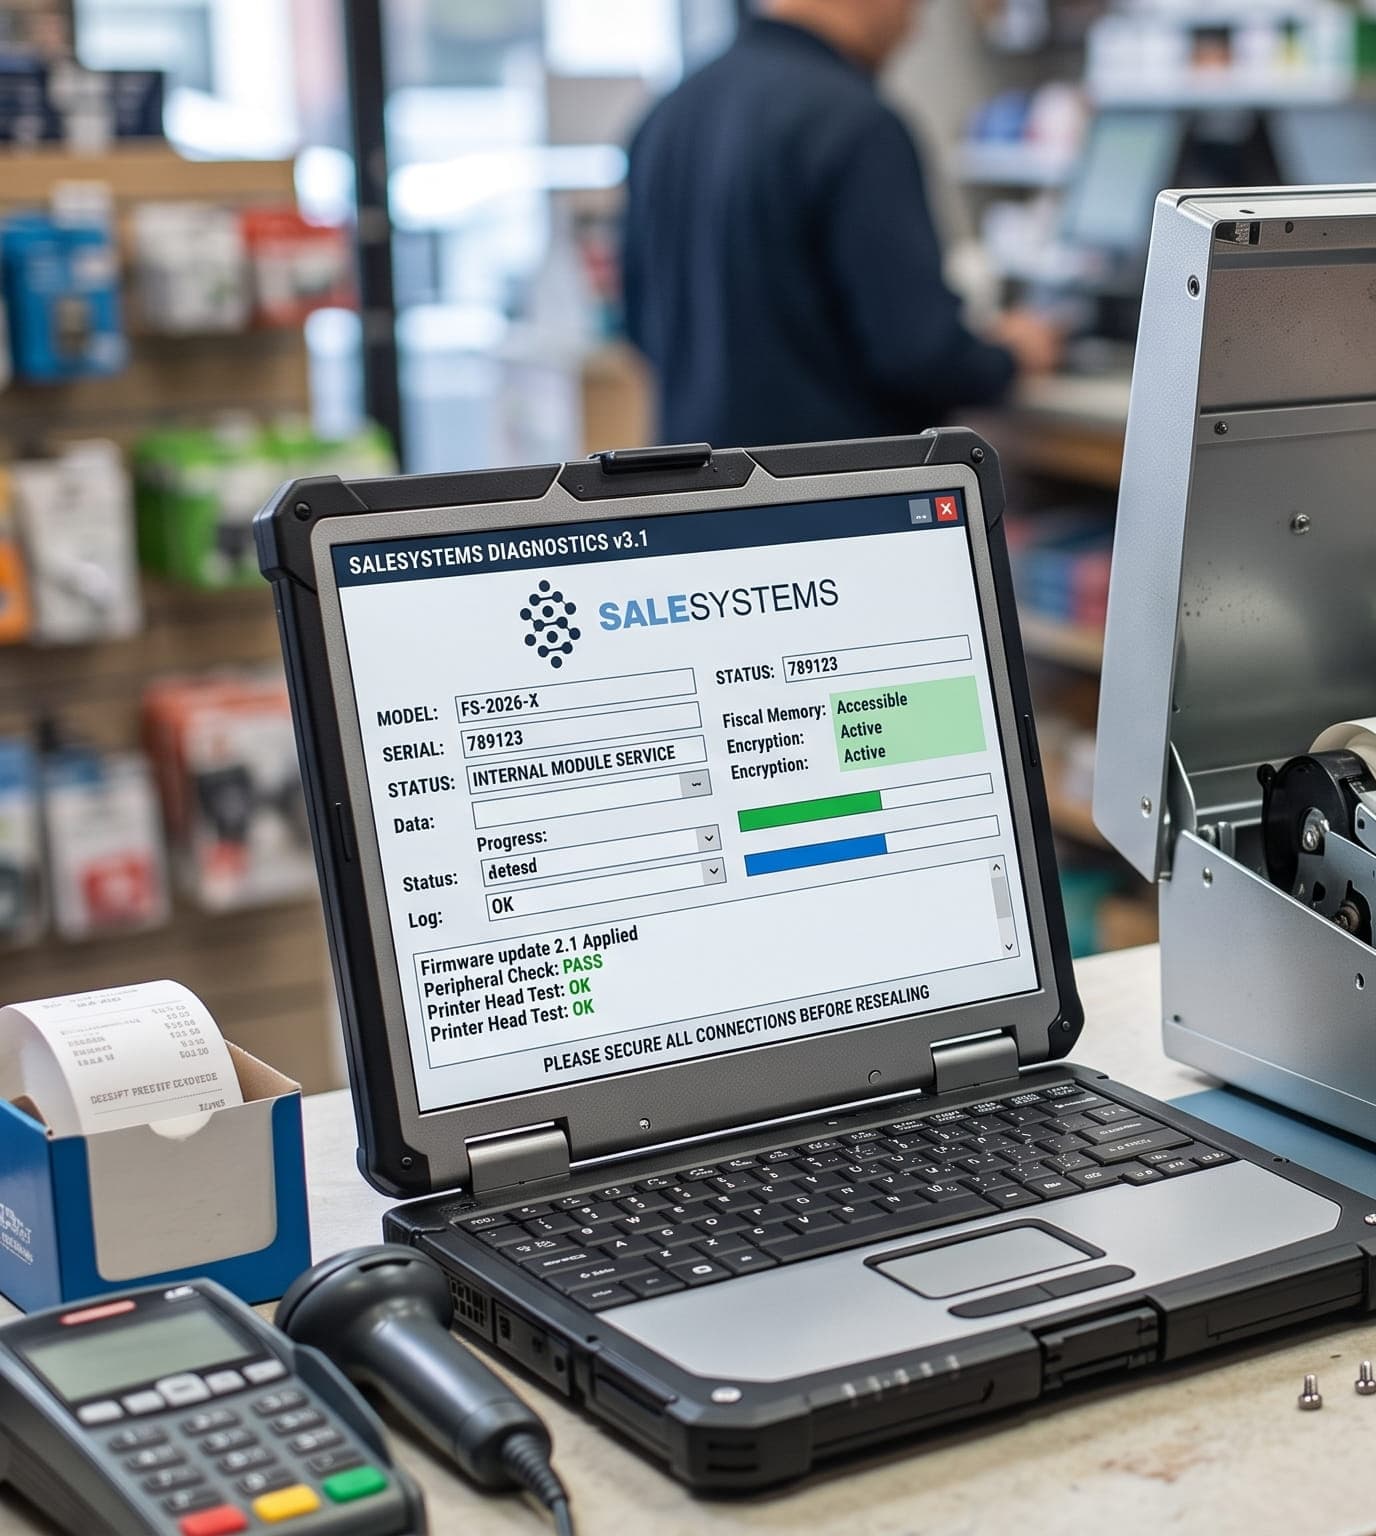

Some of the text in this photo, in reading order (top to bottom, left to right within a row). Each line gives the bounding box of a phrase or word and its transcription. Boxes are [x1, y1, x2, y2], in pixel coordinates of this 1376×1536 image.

[349, 529, 648, 575] SALESYSTEMS DIAGNOSTICS v3.1
[599, 578, 839, 631] SALESYSTEMS
[716, 664, 775, 685] STATUS:
[788, 656, 838, 676] 789123
[461, 692, 540, 716] FS-2026-X
[837, 691, 908, 715] Accessible
[377, 706, 439, 727] MODEL:
[722, 703, 827, 729] Fiscal Memory:
[466, 730, 524, 752] 789123
[840, 720, 883, 739] Active
[383, 741, 445, 762] SERIAL:
[727, 731, 805, 755] Encryption:
[844, 745, 886, 764] Active
[473, 745, 676, 787] INTERNAL MODULE SERVICE
[731, 757, 809, 780] Encryption:
[388, 775, 456, 798] STATUS:
[394, 815, 435, 834] Data:
[477, 830, 548, 853] Progress:
[403, 872, 459, 892] Status:
[492, 896, 515, 914] OK
[409, 910, 443, 929] Log:
[421, 925, 639, 976] Firmware update 2.1 Applied
[424, 954, 604, 998] Peripheral Check: PASS
[427, 977, 592, 1020] Printer Head Test: OK
[430, 999, 595, 1042] Printer Head Test: OK
[543, 984, 931, 1073] PLEASE SECURE ALL CONNECTIONS BEFORE RESEALING
